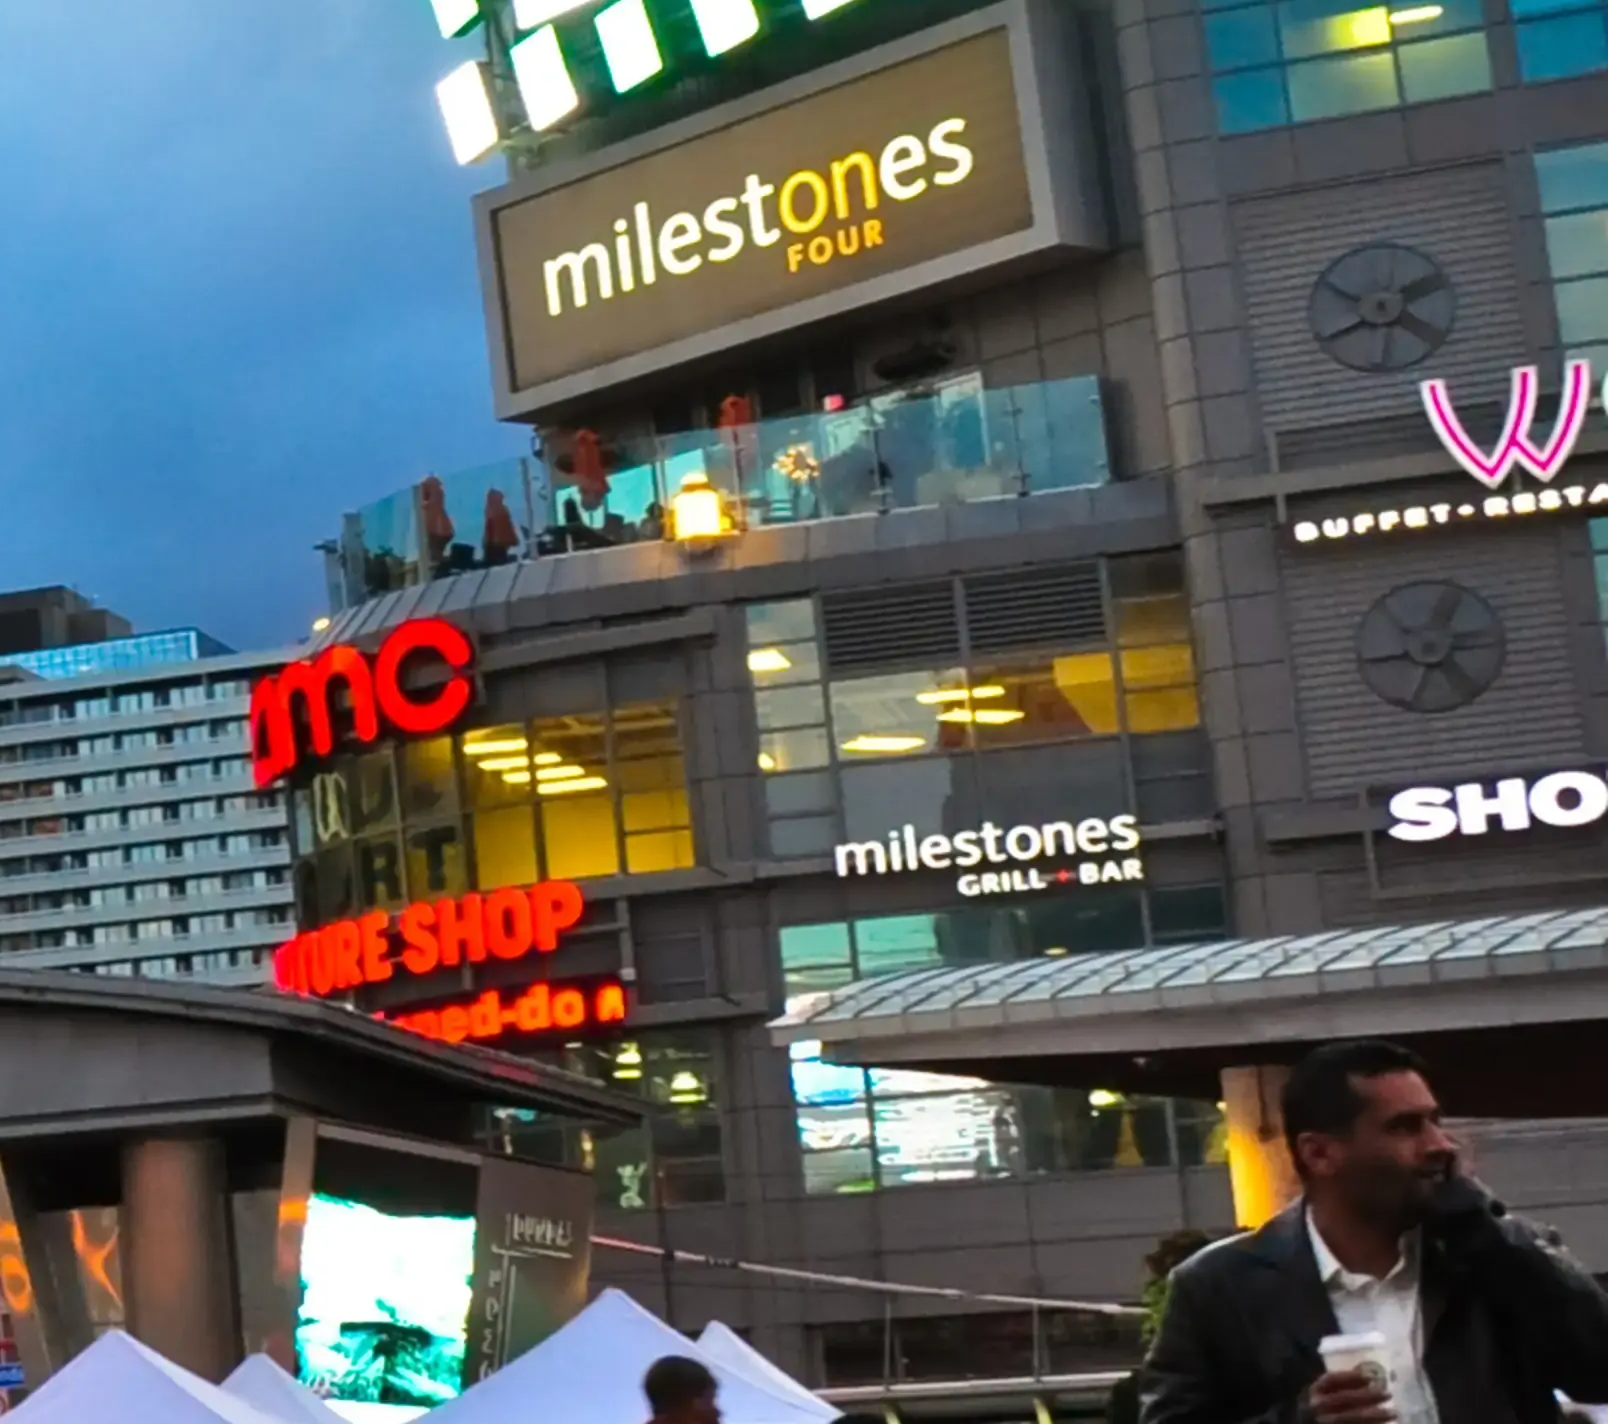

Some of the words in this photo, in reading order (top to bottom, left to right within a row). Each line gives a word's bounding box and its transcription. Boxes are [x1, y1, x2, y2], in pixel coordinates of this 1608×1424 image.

[542, 114, 975, 317] milestones
[785, 217, 885, 274] FOUR
[1420, 359, 1608, 490] W
[1293, 502, 1452, 543] BUFFET
[1387, 770, 1608, 843] SHO
[834, 812, 1139, 879] milestones
[957, 868, 1048, 898] GRILL
[1078, 857, 1143, 886] BAR
[398, 879, 584, 975] SHOP
